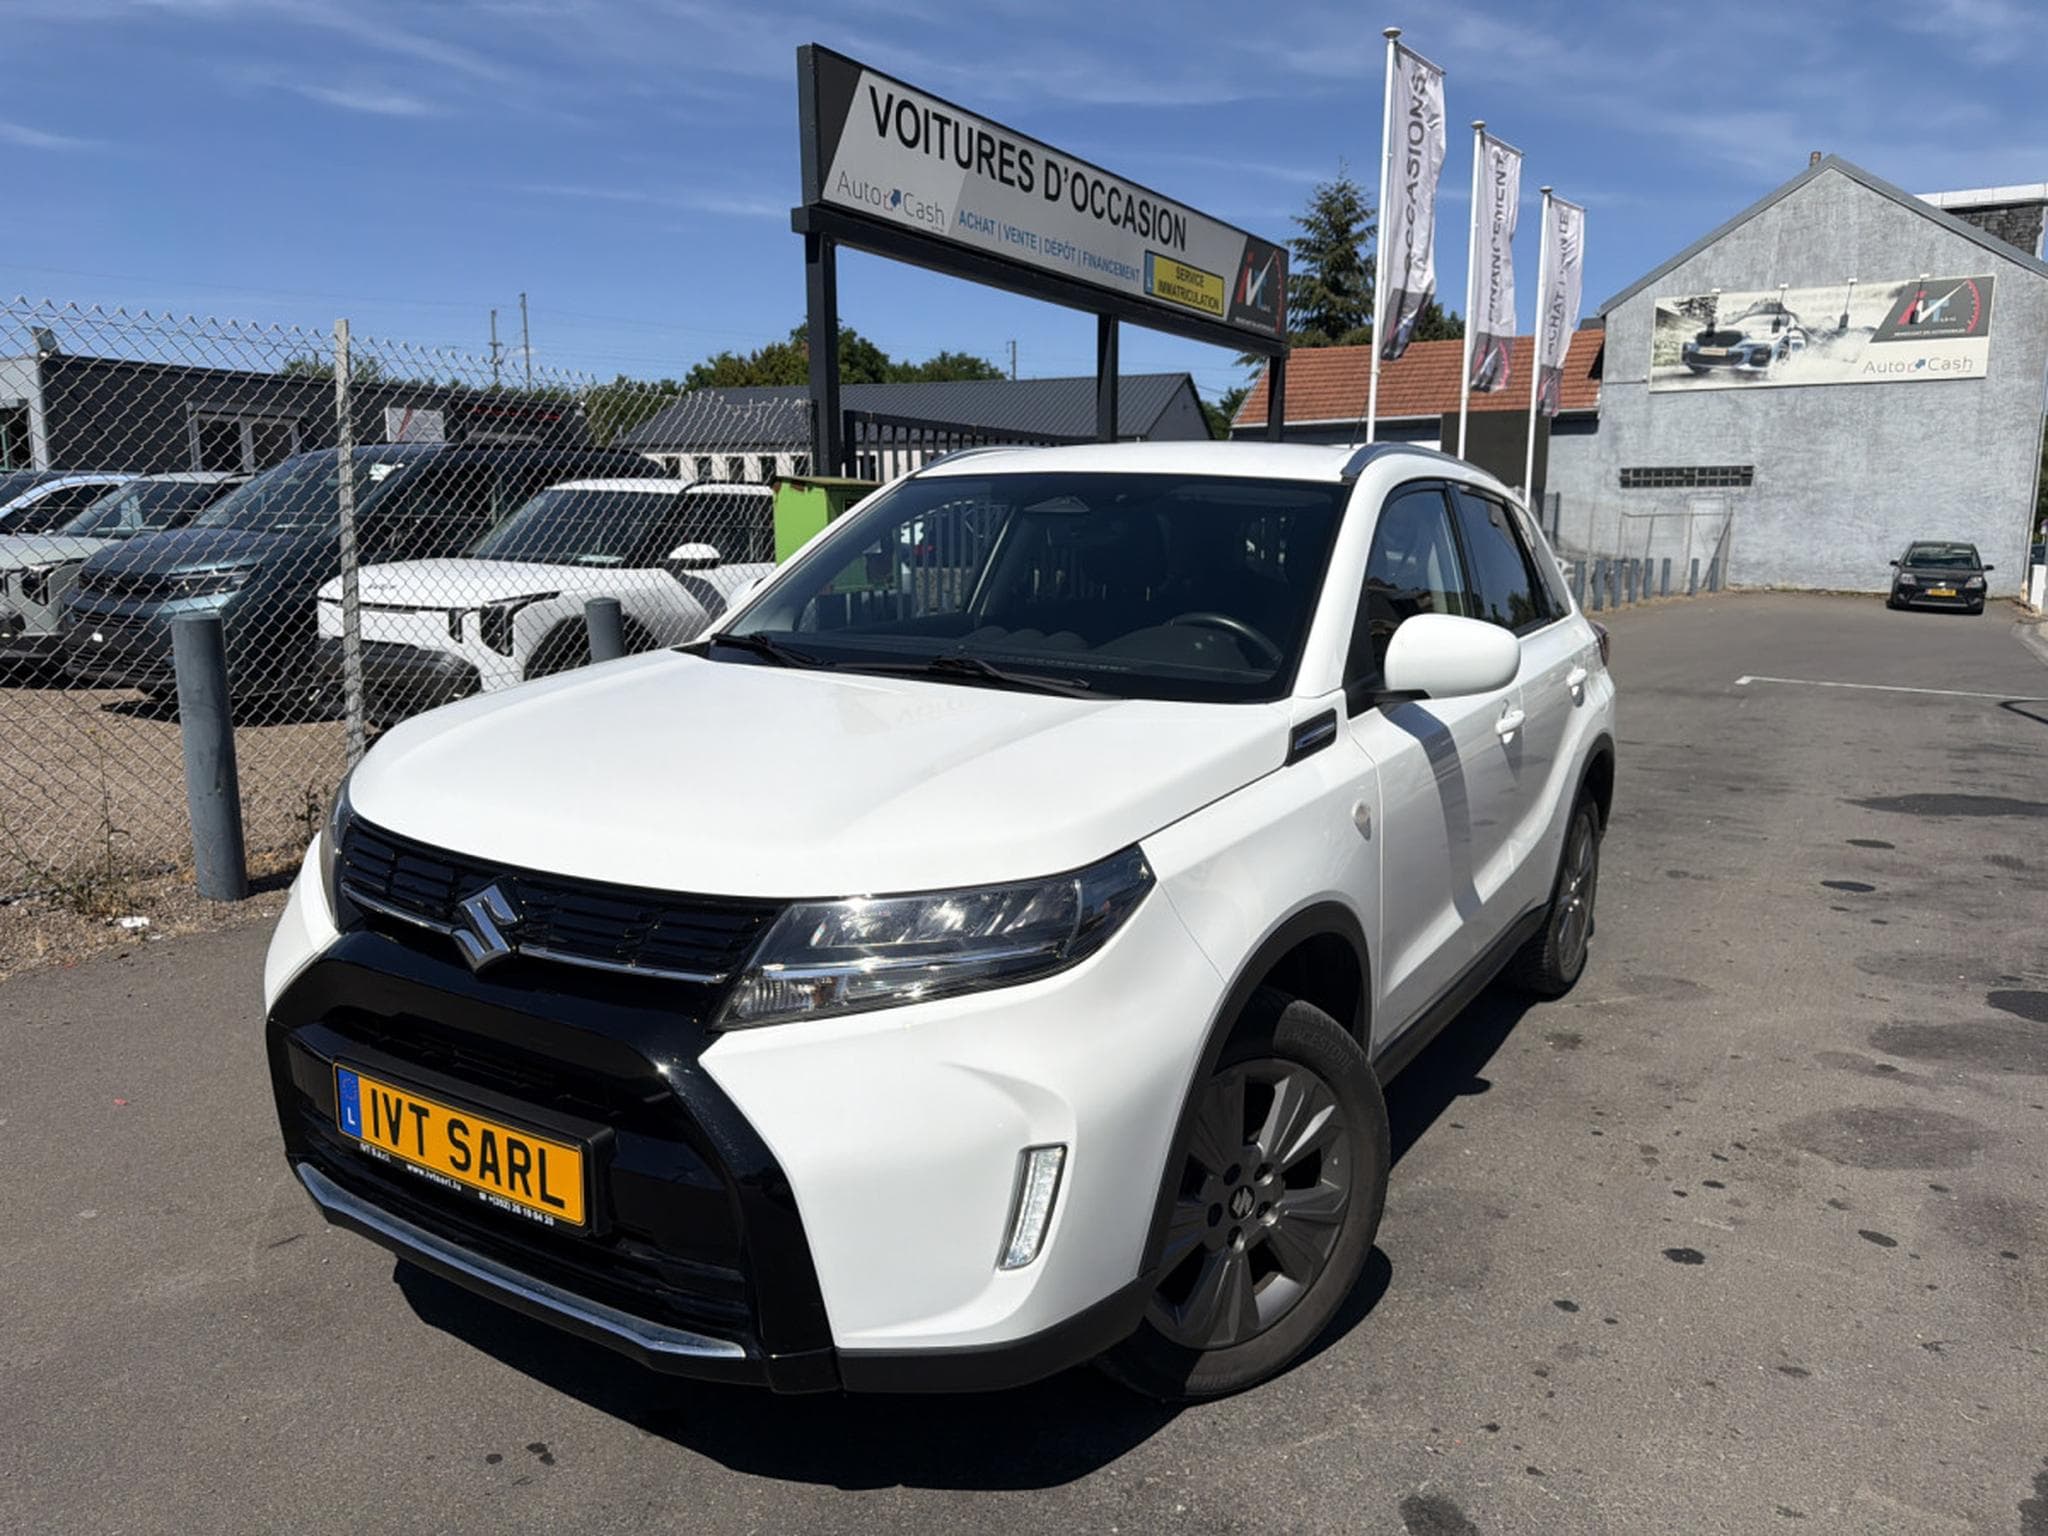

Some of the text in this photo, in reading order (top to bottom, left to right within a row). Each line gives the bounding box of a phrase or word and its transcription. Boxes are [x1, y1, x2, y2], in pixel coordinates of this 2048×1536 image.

[868, 85, 1187, 251] VOITURES D'OCCASION
[902, 191, 946, 226] Cash
[958, 209, 996, 236] ACHAT
[1003, 224, 1037, 251] VENTE
[1082, 250, 1141, 283] FINANCEMENT
[1175, 265, 1205, 288] SERVICE
[1862, 355, 1974, 374] Auto Cash
[346, 1106, 356, 1126] L
[370, 1087, 566, 1211] IVT SARL
